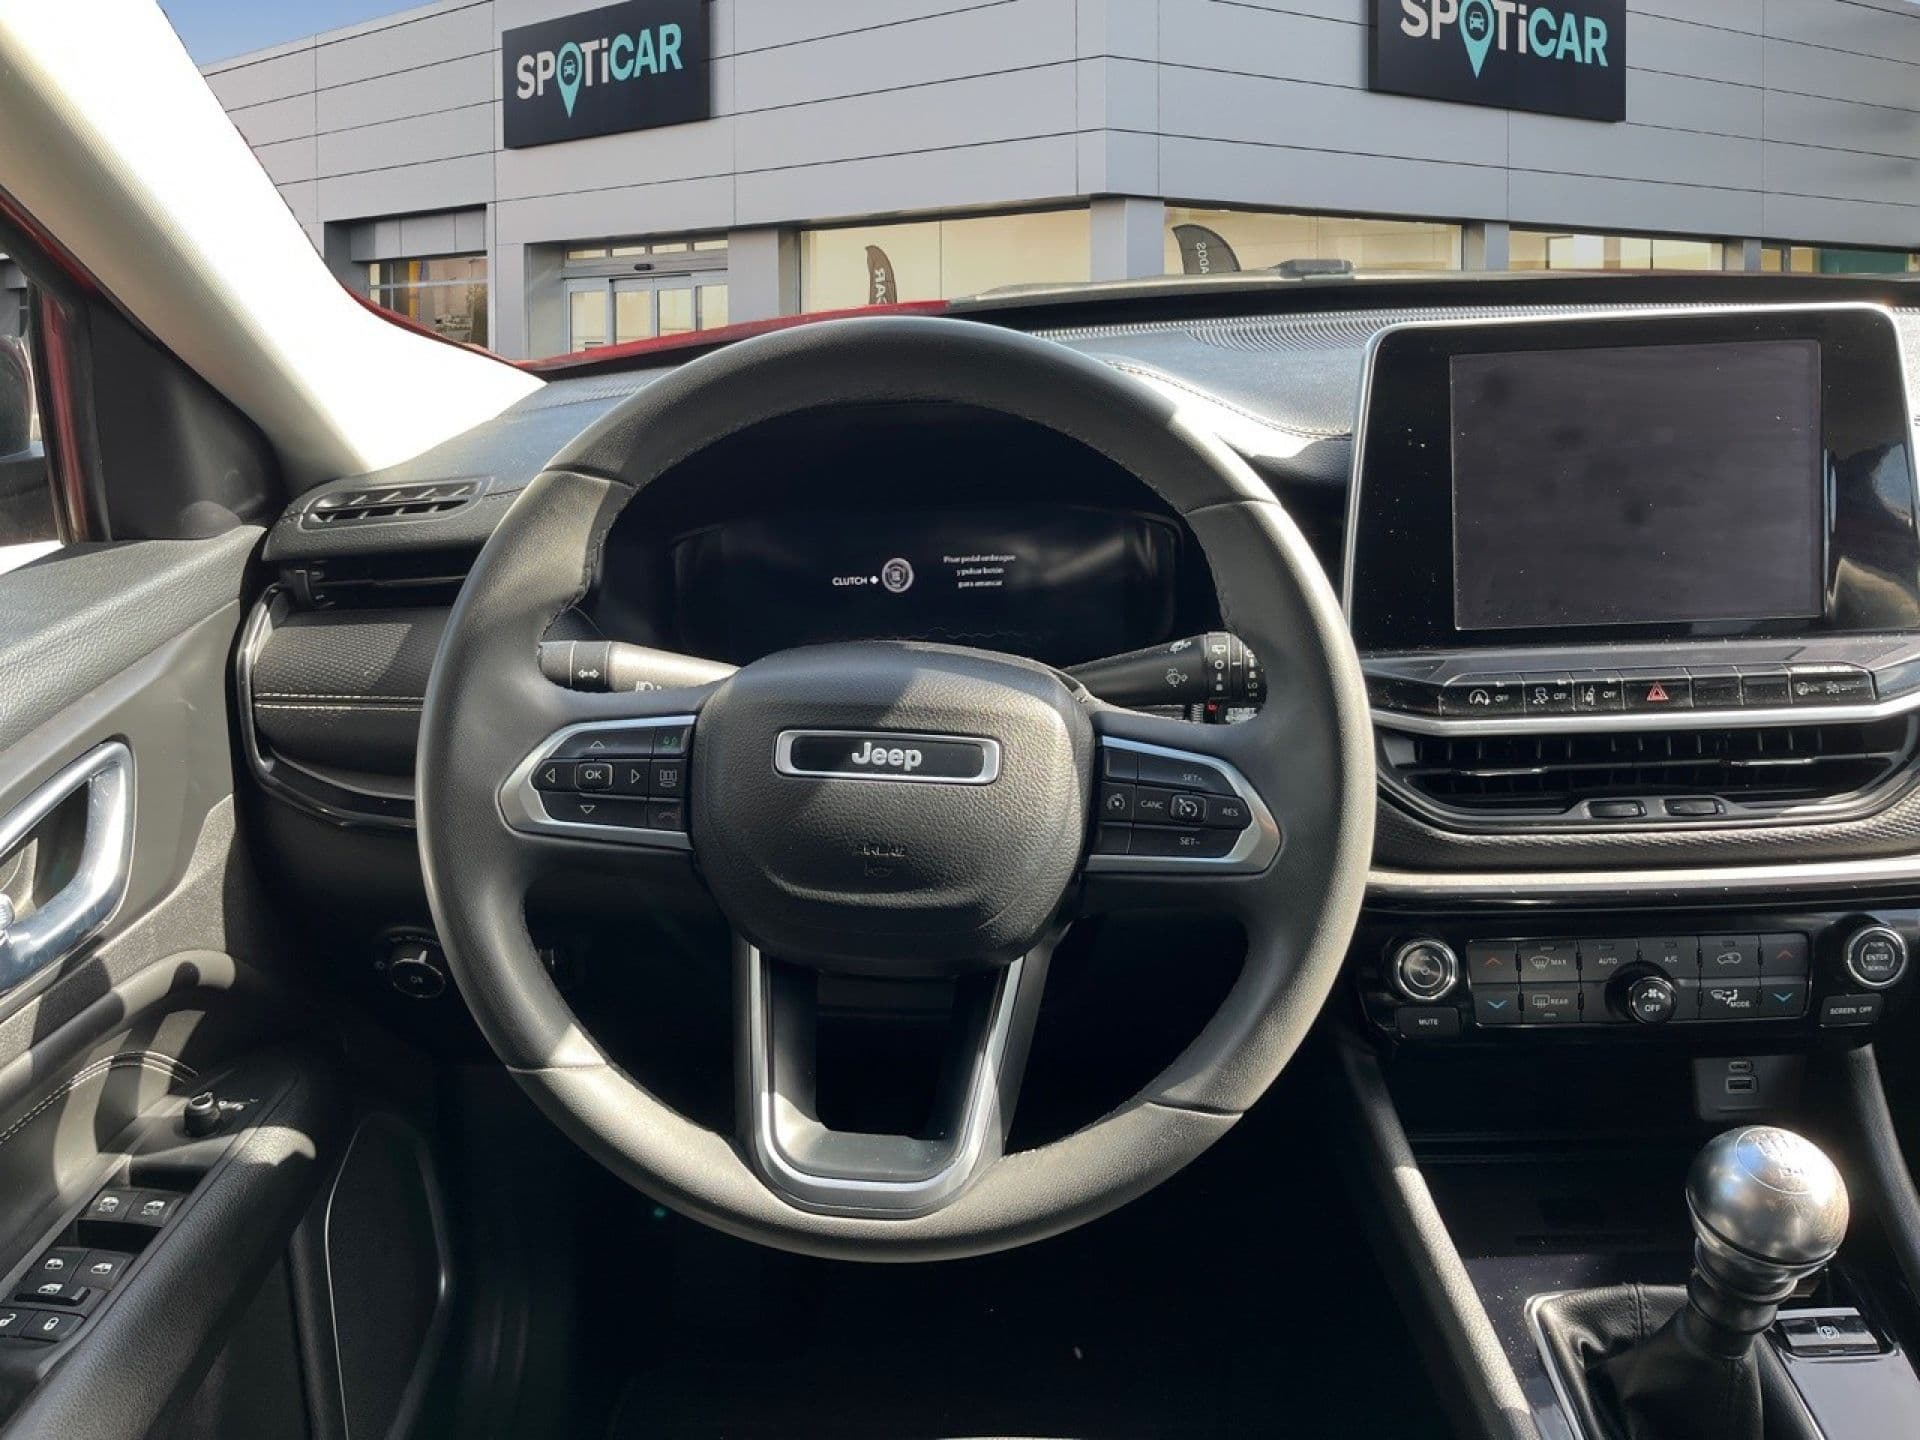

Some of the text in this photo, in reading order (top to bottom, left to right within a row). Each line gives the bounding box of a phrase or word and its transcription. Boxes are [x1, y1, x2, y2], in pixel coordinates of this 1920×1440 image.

[832, 577, 868, 586] CLUTCH
[851, 741, 922, 771] Jeep
[584, 770, 602, 780] OK
[1222, 807, 1238, 817] RES
[1599, 957, 1618, 965] AUTO
[1866, 953, 1889, 961] ENTER
[1644, 1004, 1661, 1012] OFF
[1418, 1018, 1438, 1026] MUTE
